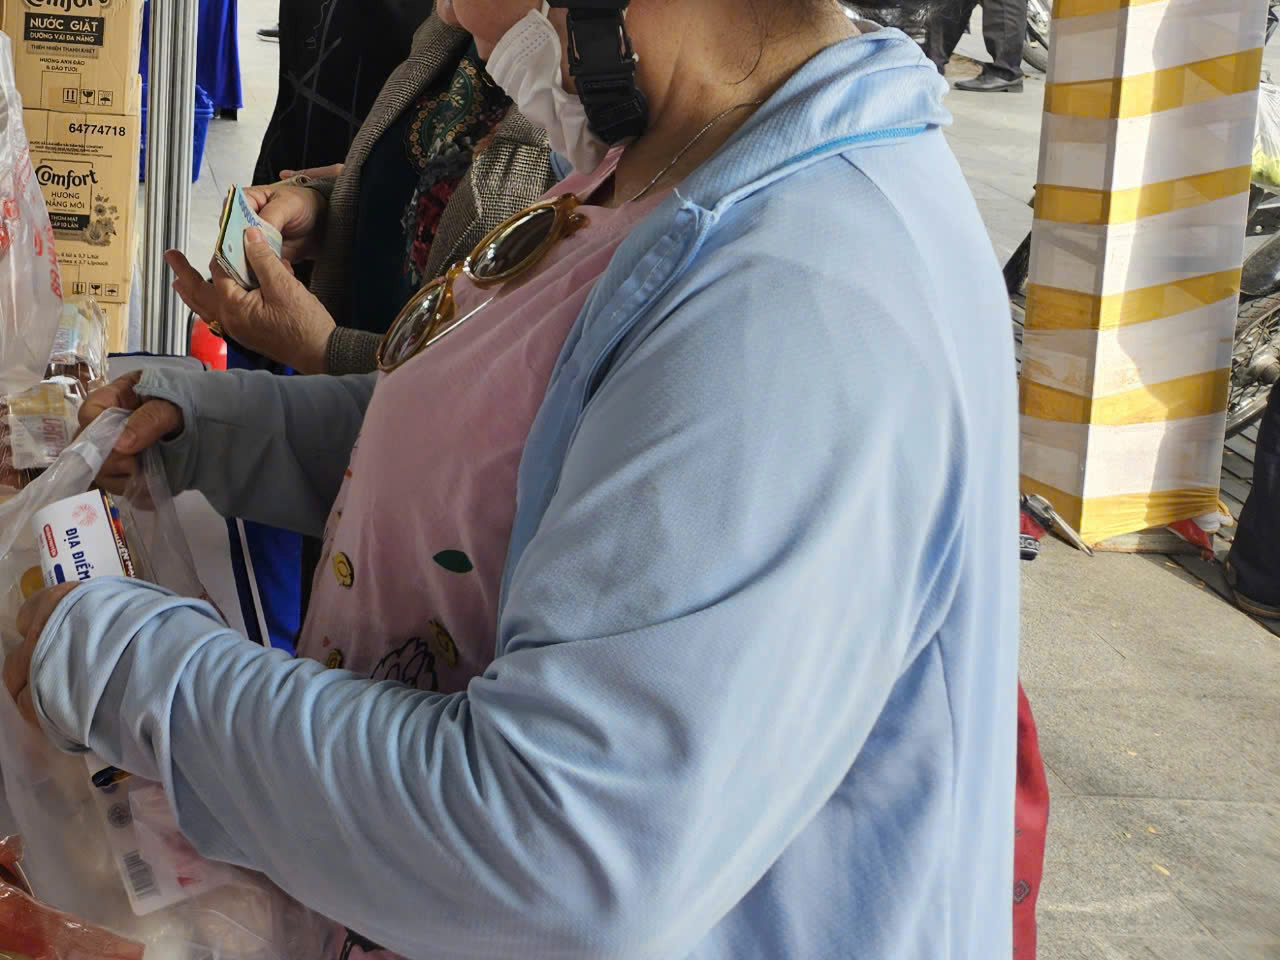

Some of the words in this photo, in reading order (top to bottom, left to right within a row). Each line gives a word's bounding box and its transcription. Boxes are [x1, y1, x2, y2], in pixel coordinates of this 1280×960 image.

[30, 16, 64, 30] NƯỚC
[70, 19, 99, 34] GIẶT
[68, 123, 126, 137] 64774718
[35, 165, 99, 190] Comfort
[63, 527, 81, 549] ĐỊA
[72, 551, 95, 581] ĐIỂM
